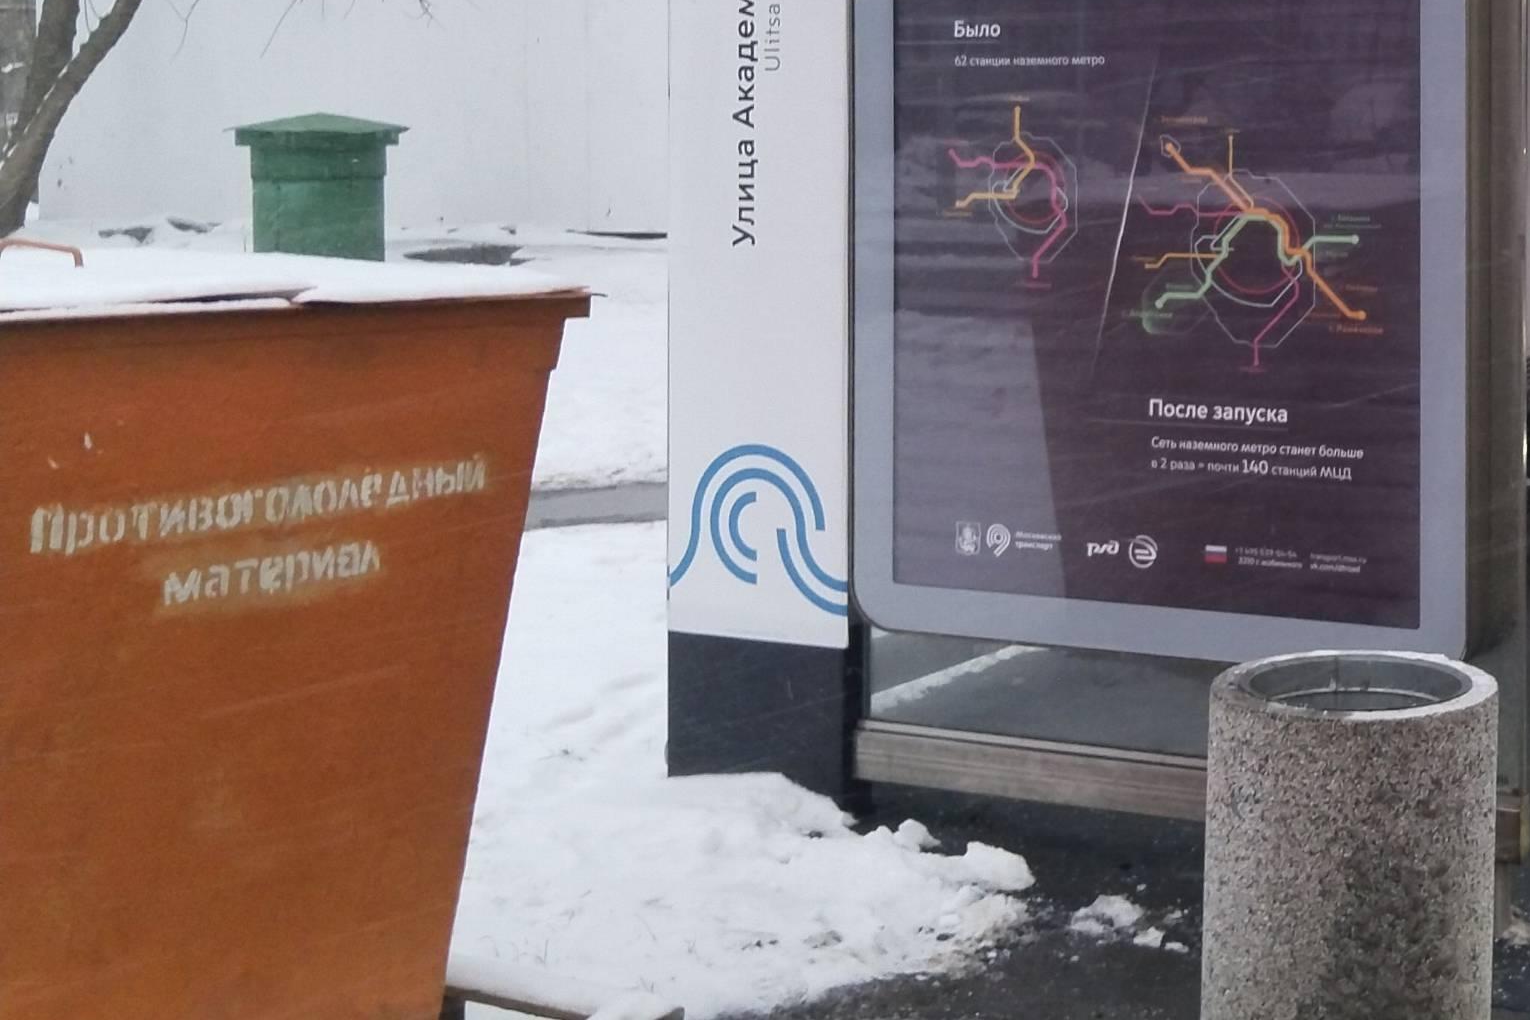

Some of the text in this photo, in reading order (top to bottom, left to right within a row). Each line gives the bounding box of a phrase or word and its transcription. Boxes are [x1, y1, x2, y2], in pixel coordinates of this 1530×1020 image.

[764, 3, 781, 71] Ulitsa
[953, 20, 1001, 38] Было
[954, 55, 1105, 68] 62 станции наземного метро
[732, 140, 758, 246] Улица
[1149, 398, 1288, 425] После запуска
[1151, 436, 1364, 459] Сеть наземного метро станет больше
[1160, 458, 1167, 469] 2
[1170, 460, 1195, 471] раза
[1207, 461, 1239, 473] почти
[1242, 459, 1269, 475] 140
[1271, 464, 1317, 478] станций
[1319, 467, 1352, 481] МЦД
